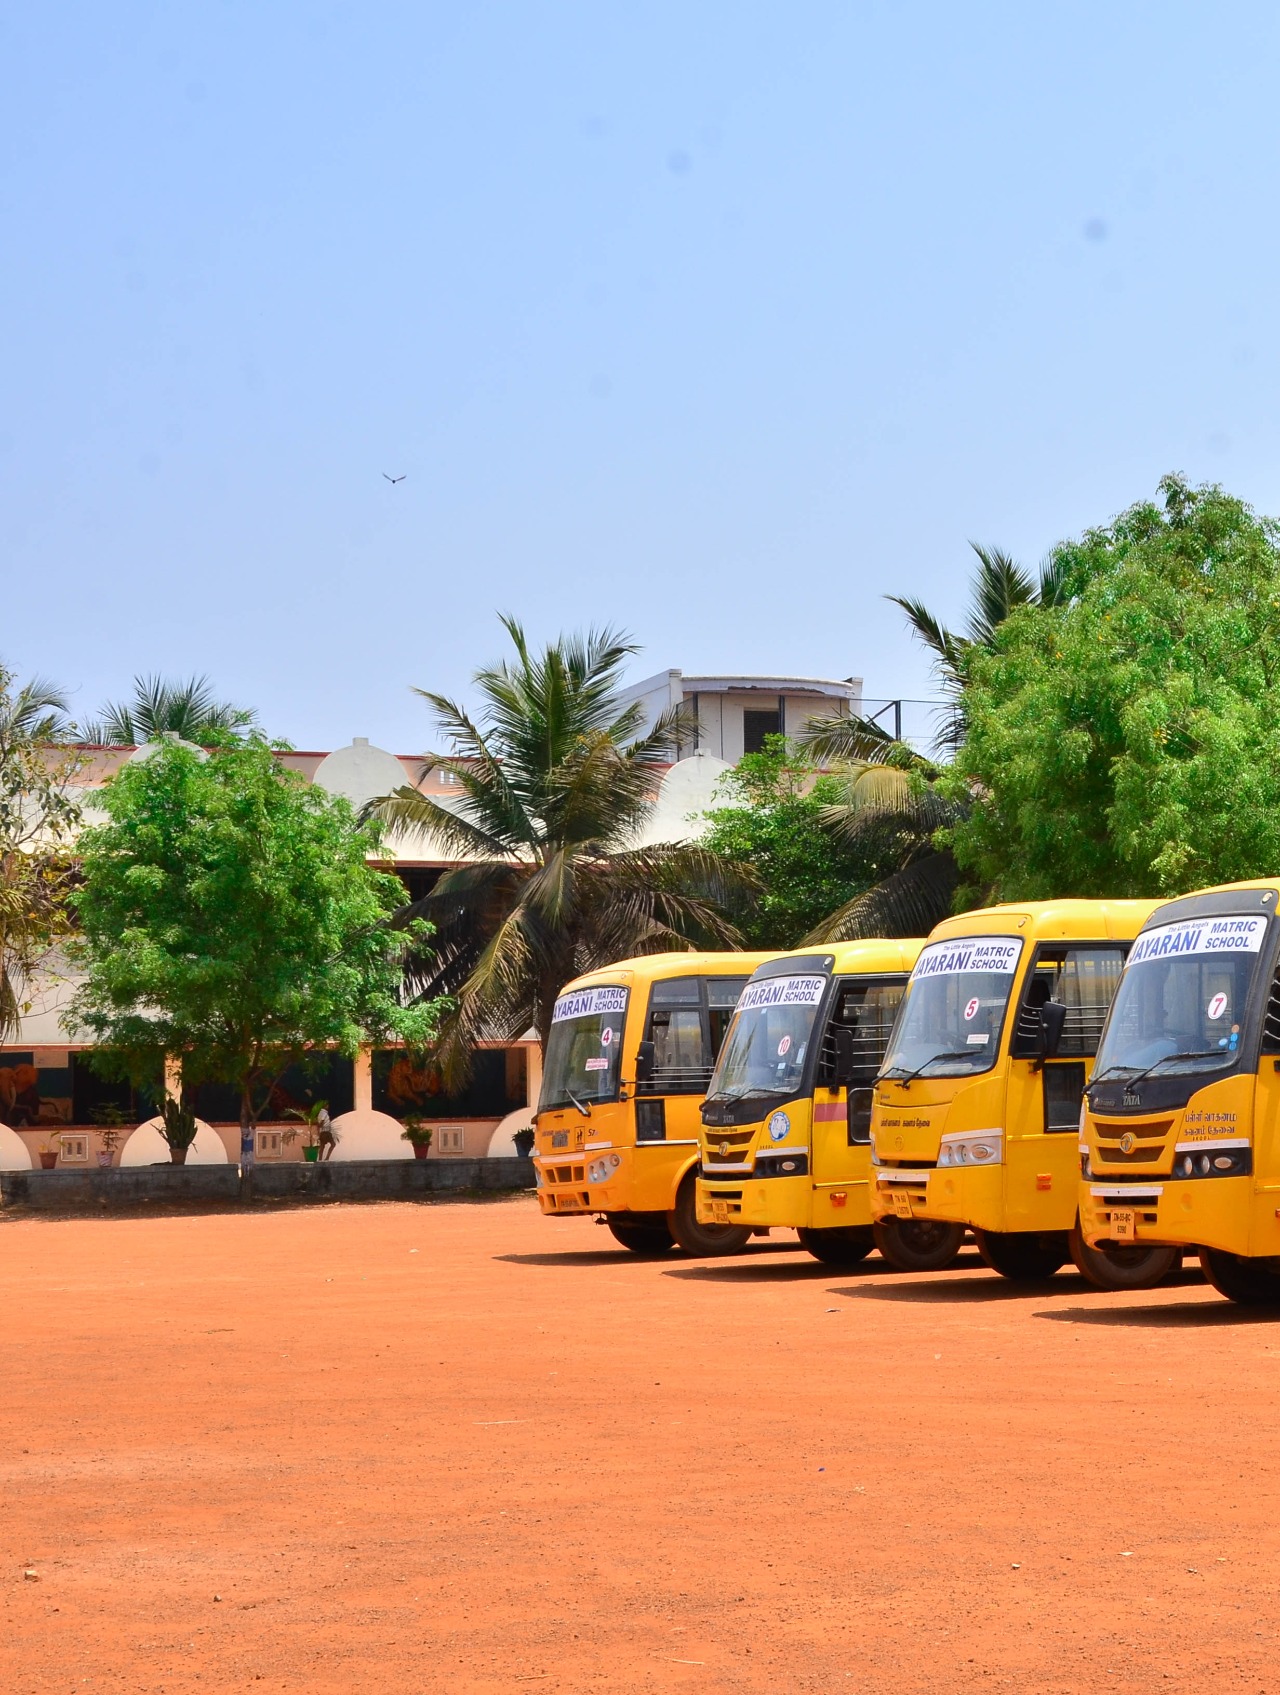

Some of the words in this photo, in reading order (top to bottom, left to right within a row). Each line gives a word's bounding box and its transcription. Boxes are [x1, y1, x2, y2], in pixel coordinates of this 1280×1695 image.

[1191, 922, 1209, 930] Angels
[1210, 921, 1258, 933] MATRIC
[1128, 930, 1202, 964] JAYARANI
[1205, 937, 1250, 949] SCHOOL
[975, 947, 1015, 957] MATRIC
[970, 959, 1008, 970] SCHOOL
[787, 980, 821, 990] MATRIC
[597, 989, 626, 1000] MATRIC
[784, 991, 816, 1002] SCHOOL
[553, 996, 593, 1020] AYARANI
[594, 1000, 624, 1011] SCHOOL
[966, 1000, 977, 1017] 5
[1212, 997, 1224, 1016] 7
[603, 1030, 610, 1043] 4
[780, 1039, 789, 1053] 10
[1122, 1094, 1140, 1106] TATA
